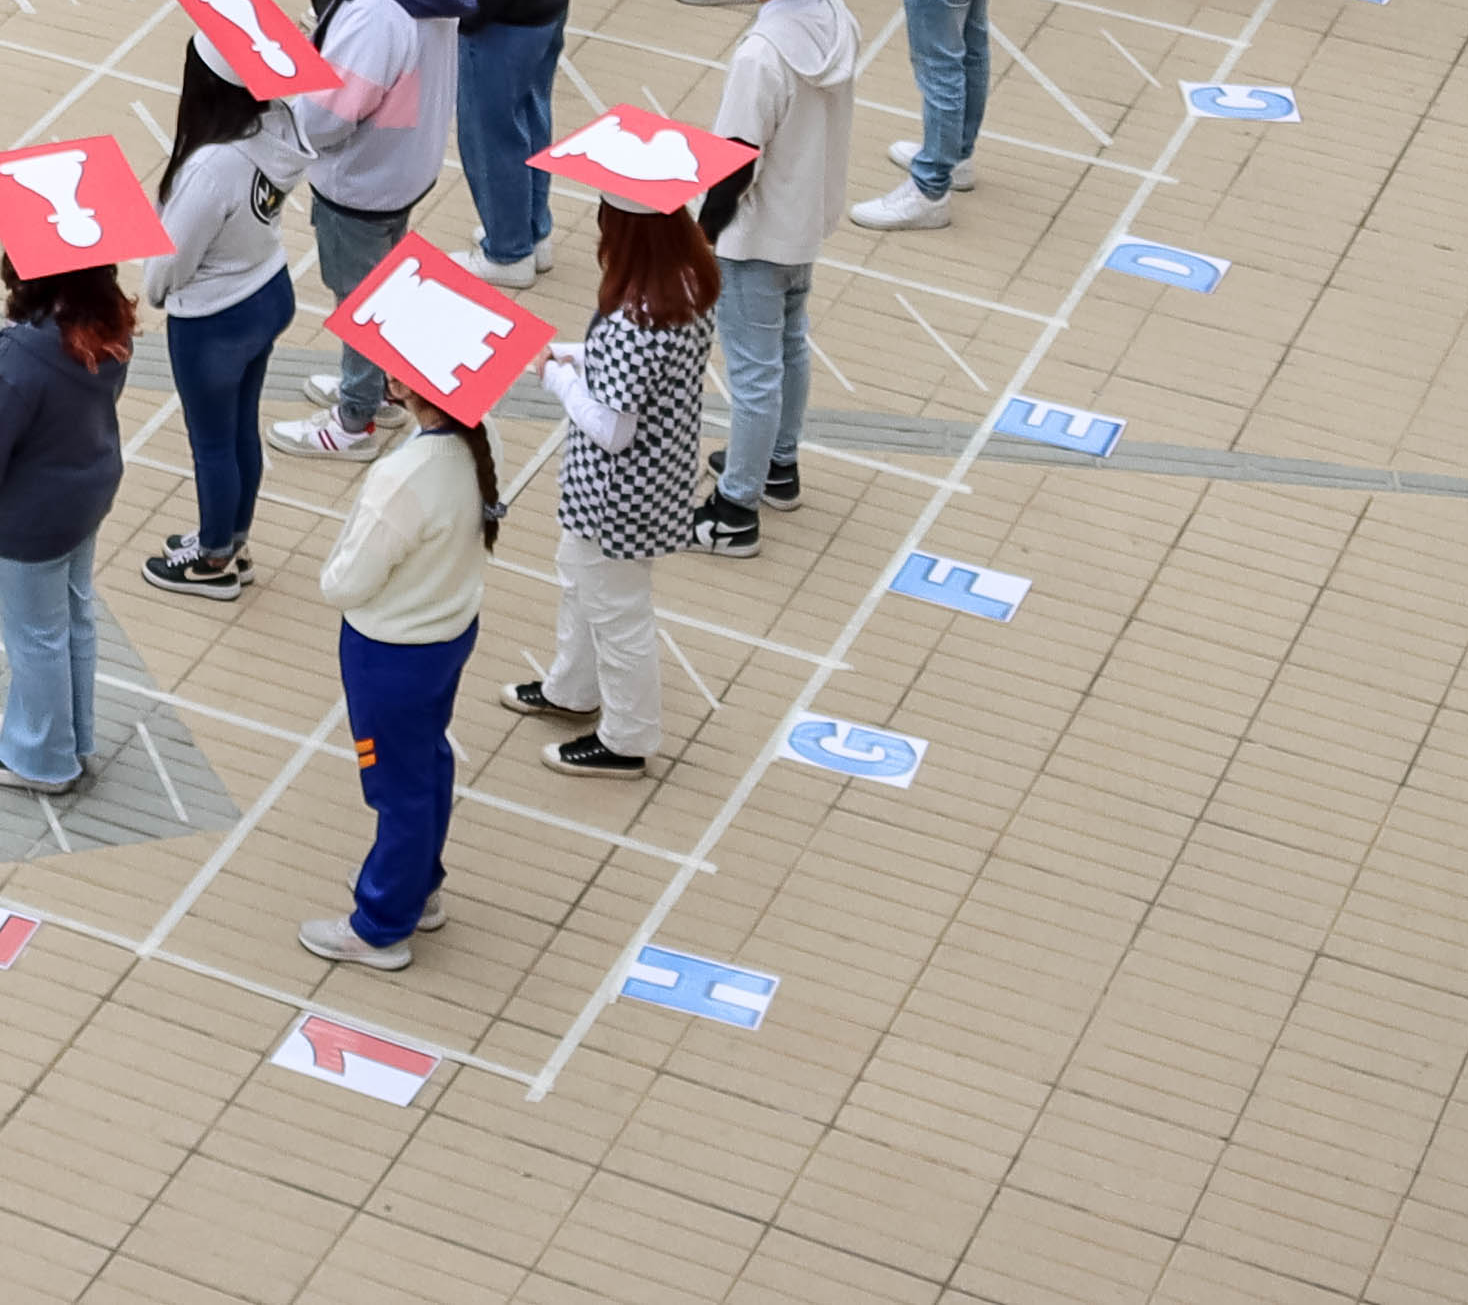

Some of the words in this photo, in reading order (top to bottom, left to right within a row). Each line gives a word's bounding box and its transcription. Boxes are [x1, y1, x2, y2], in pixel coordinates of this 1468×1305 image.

[1189, 85, 1296, 120] C
[1104, 242, 1222, 293] D
[993, 397, 1124, 457] E
[889, 551, 1016, 622] F
[787, 720, 918, 779] G
[619, 943, 778, 1030] H
[300, 1015, 443, 1077] 1
